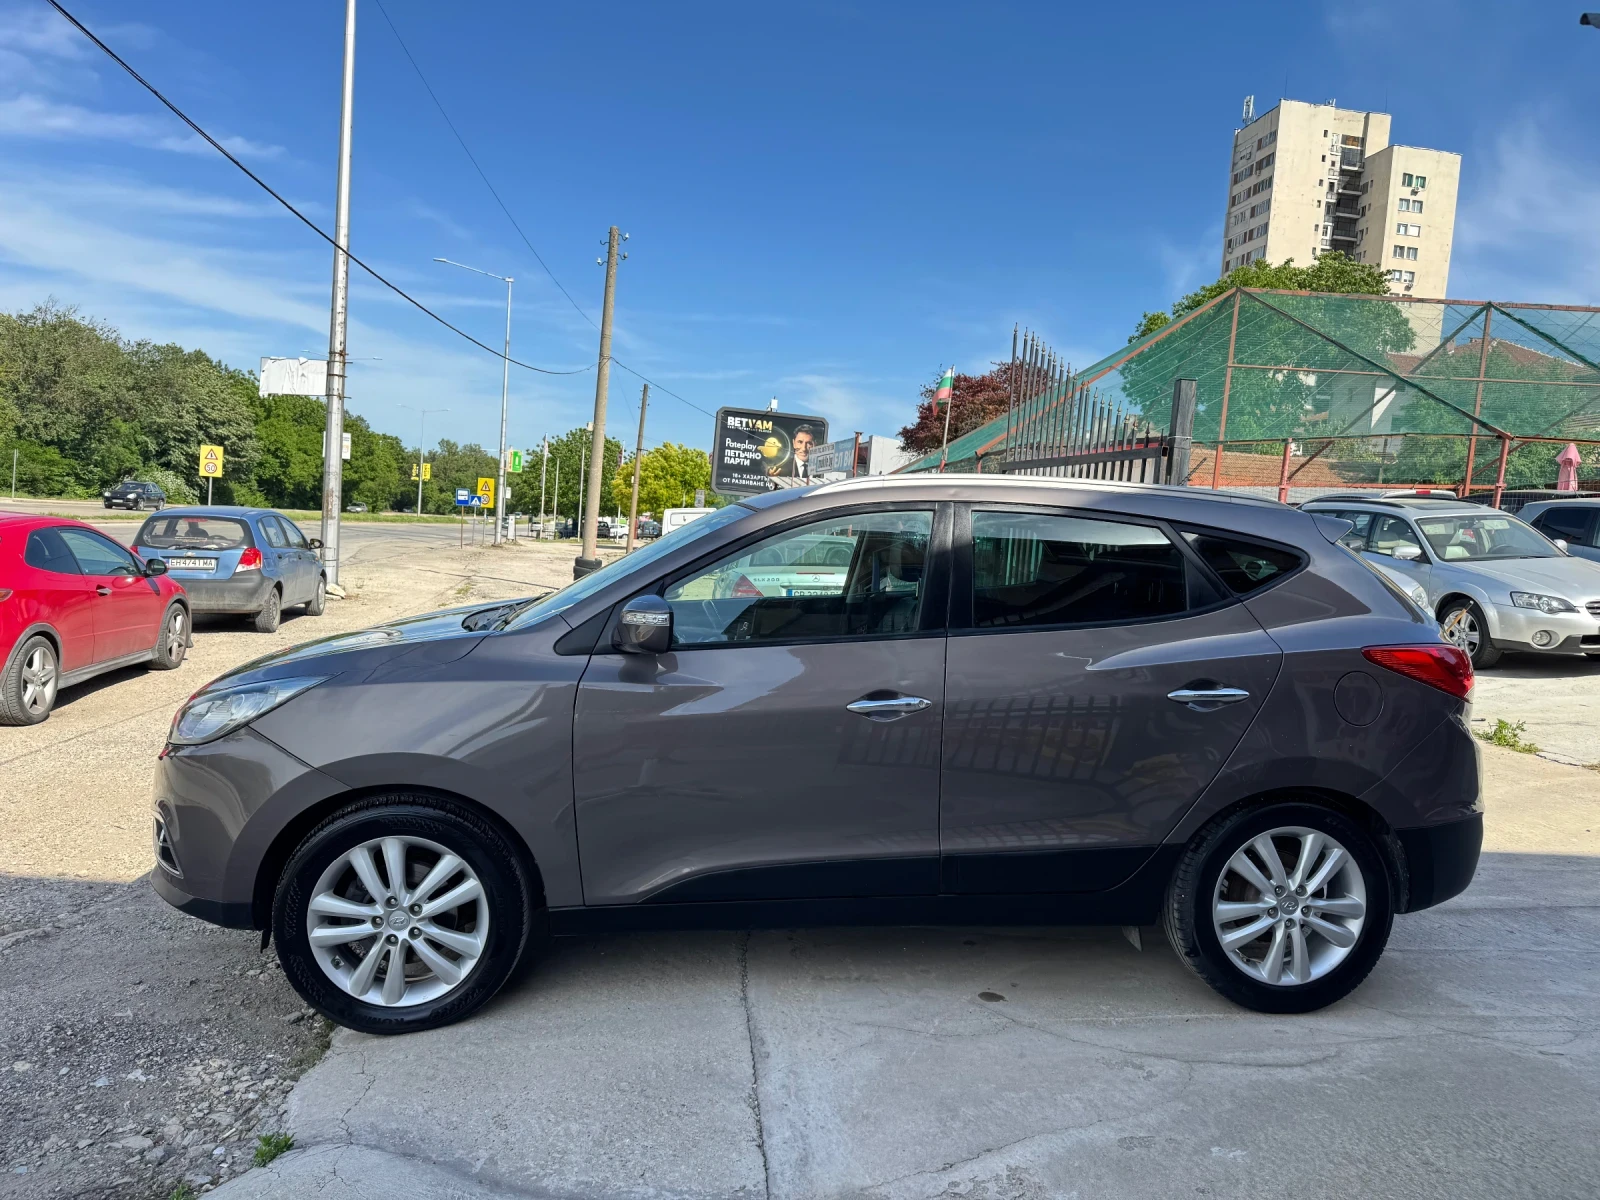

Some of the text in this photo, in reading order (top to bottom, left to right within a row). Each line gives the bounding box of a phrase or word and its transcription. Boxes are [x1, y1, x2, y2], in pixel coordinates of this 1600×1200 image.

[725, 437, 757, 451] Pateplay
[725, 449, 762, 460] ПЕТЪЧНО
[724, 456, 751, 466] ПАРТИ
[206, 464, 216, 472] 50
[731, 479, 765, 487] РАЗВИВАНЕ
